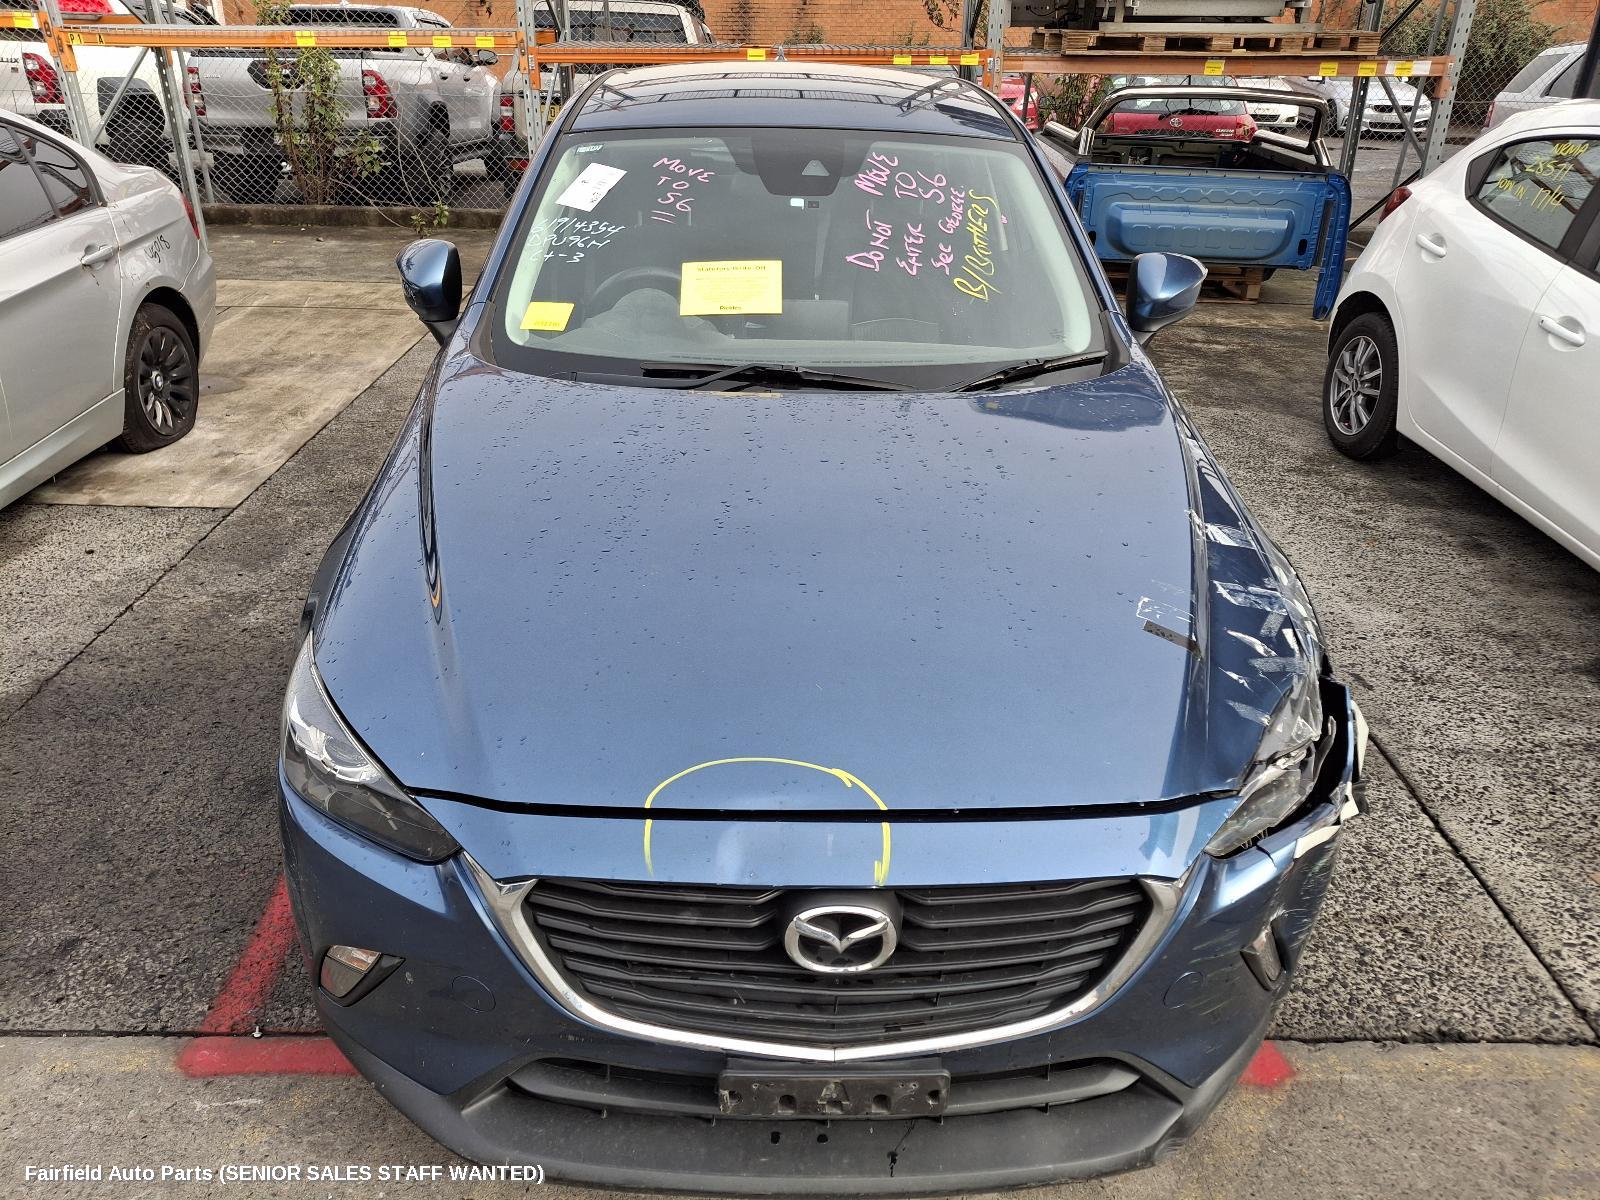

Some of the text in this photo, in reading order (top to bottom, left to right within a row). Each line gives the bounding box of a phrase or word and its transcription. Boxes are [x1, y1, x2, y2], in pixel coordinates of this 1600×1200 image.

[652, 157, 716, 182] MOVE
[656, 176, 690, 189] TO
[854, 152, 899, 196] MOVE
[894, 172, 917, 199] TO
[866, 208, 893, 250] NOT
[896, 222, 926, 276] ENTER
